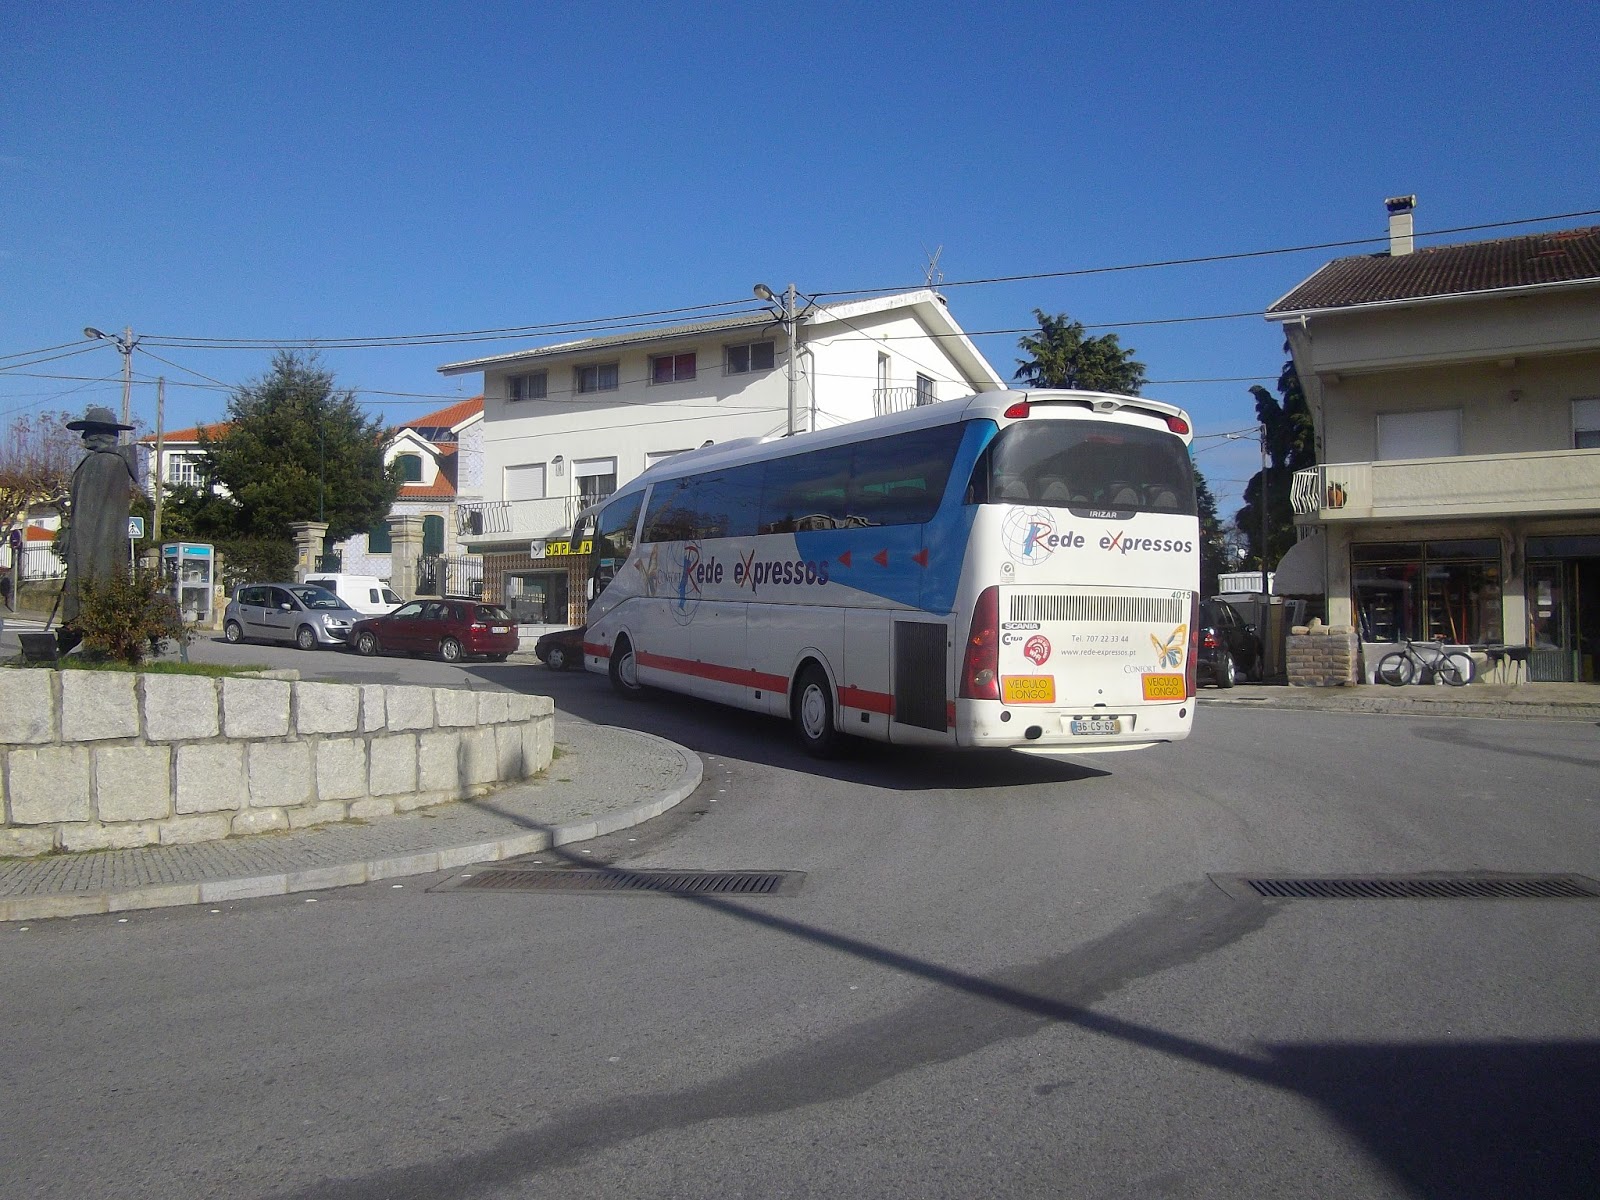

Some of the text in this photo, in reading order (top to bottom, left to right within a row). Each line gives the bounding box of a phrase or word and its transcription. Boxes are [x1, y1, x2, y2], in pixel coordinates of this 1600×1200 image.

[1089, 510, 1117, 519] IRIZAR
[1024, 522, 1085, 553] Rede
[546, 542, 592, 555] SAPA
[685, 545, 723, 594] Rede
[1171, 591, 1191, 600] 4015
[1004, 622, 1039, 630] SCANIA
[1072, 635, 1129, 643] Tel. 707 22 33 44
[1061, 648, 1137, 657] www.rede-expressos.pt
[1008, 679, 1047, 689] VEICULO
[1011, 689, 1046, 699] LONGO
[1149, 687, 1179, 696] LONGO
